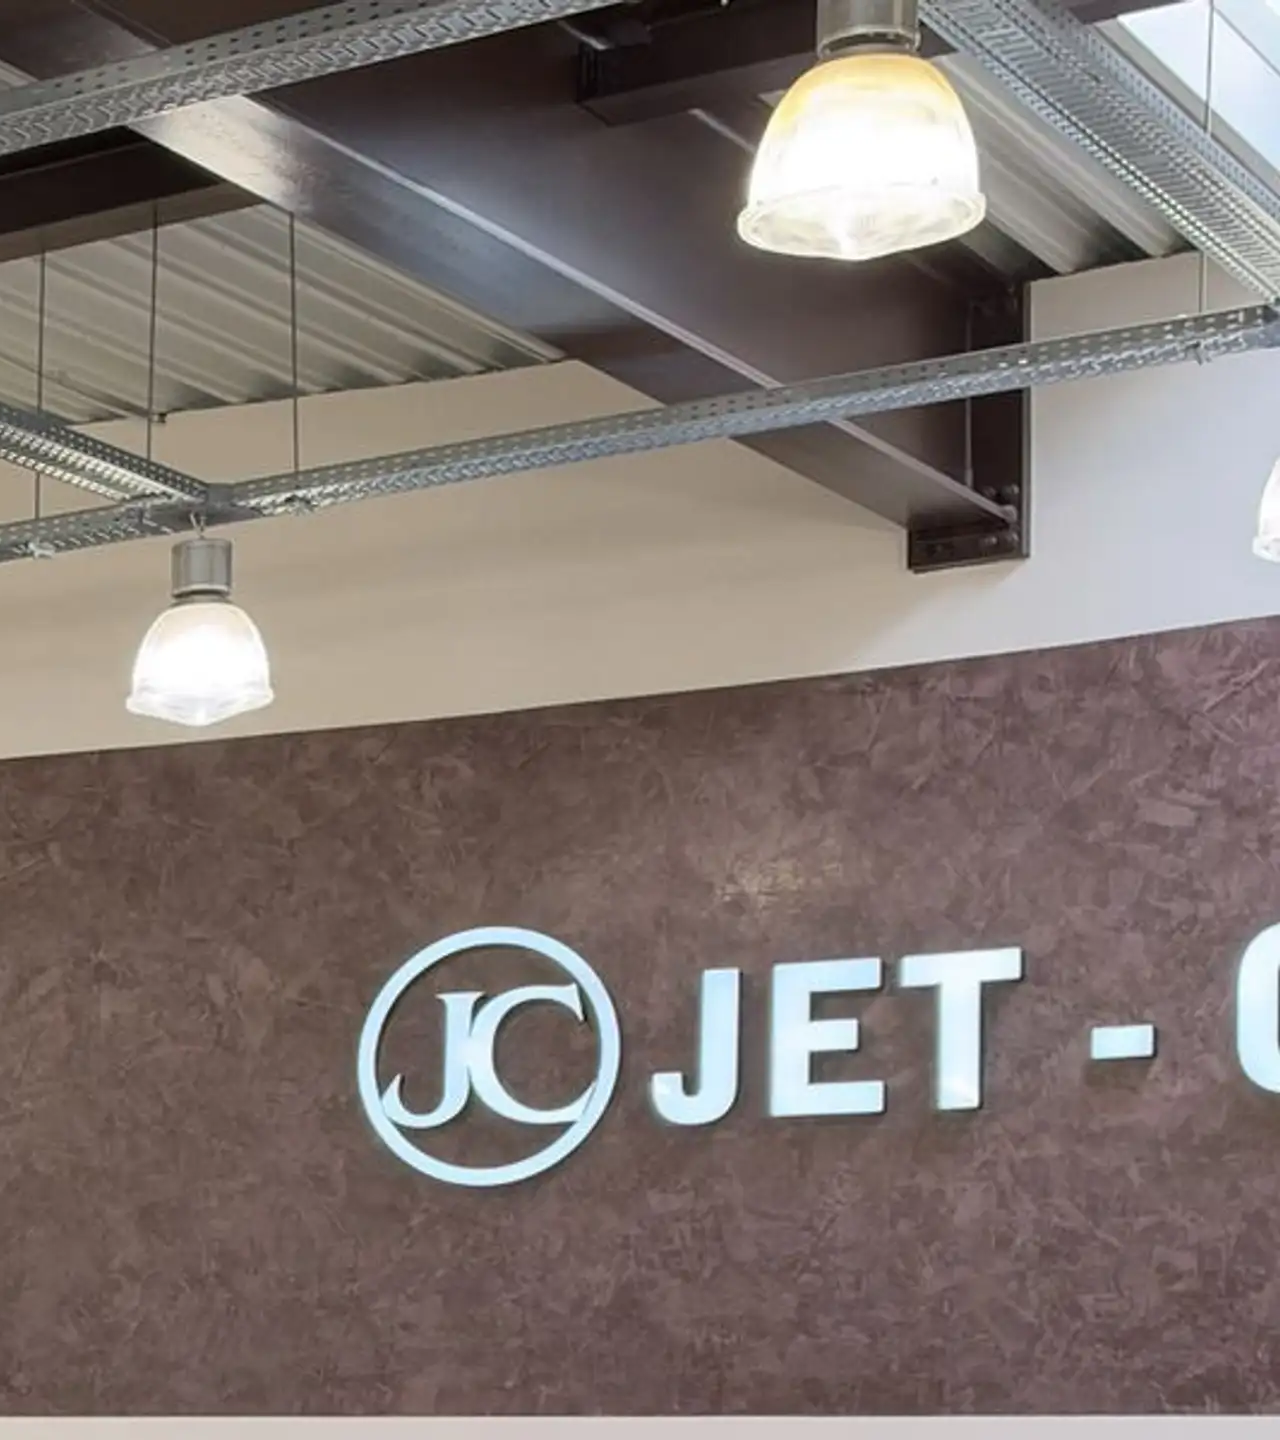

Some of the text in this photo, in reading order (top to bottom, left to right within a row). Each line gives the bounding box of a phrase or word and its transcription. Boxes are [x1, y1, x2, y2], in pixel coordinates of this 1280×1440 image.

[380, 981, 599, 1130] JC
[650, 946, 1155, 1126] JET -
